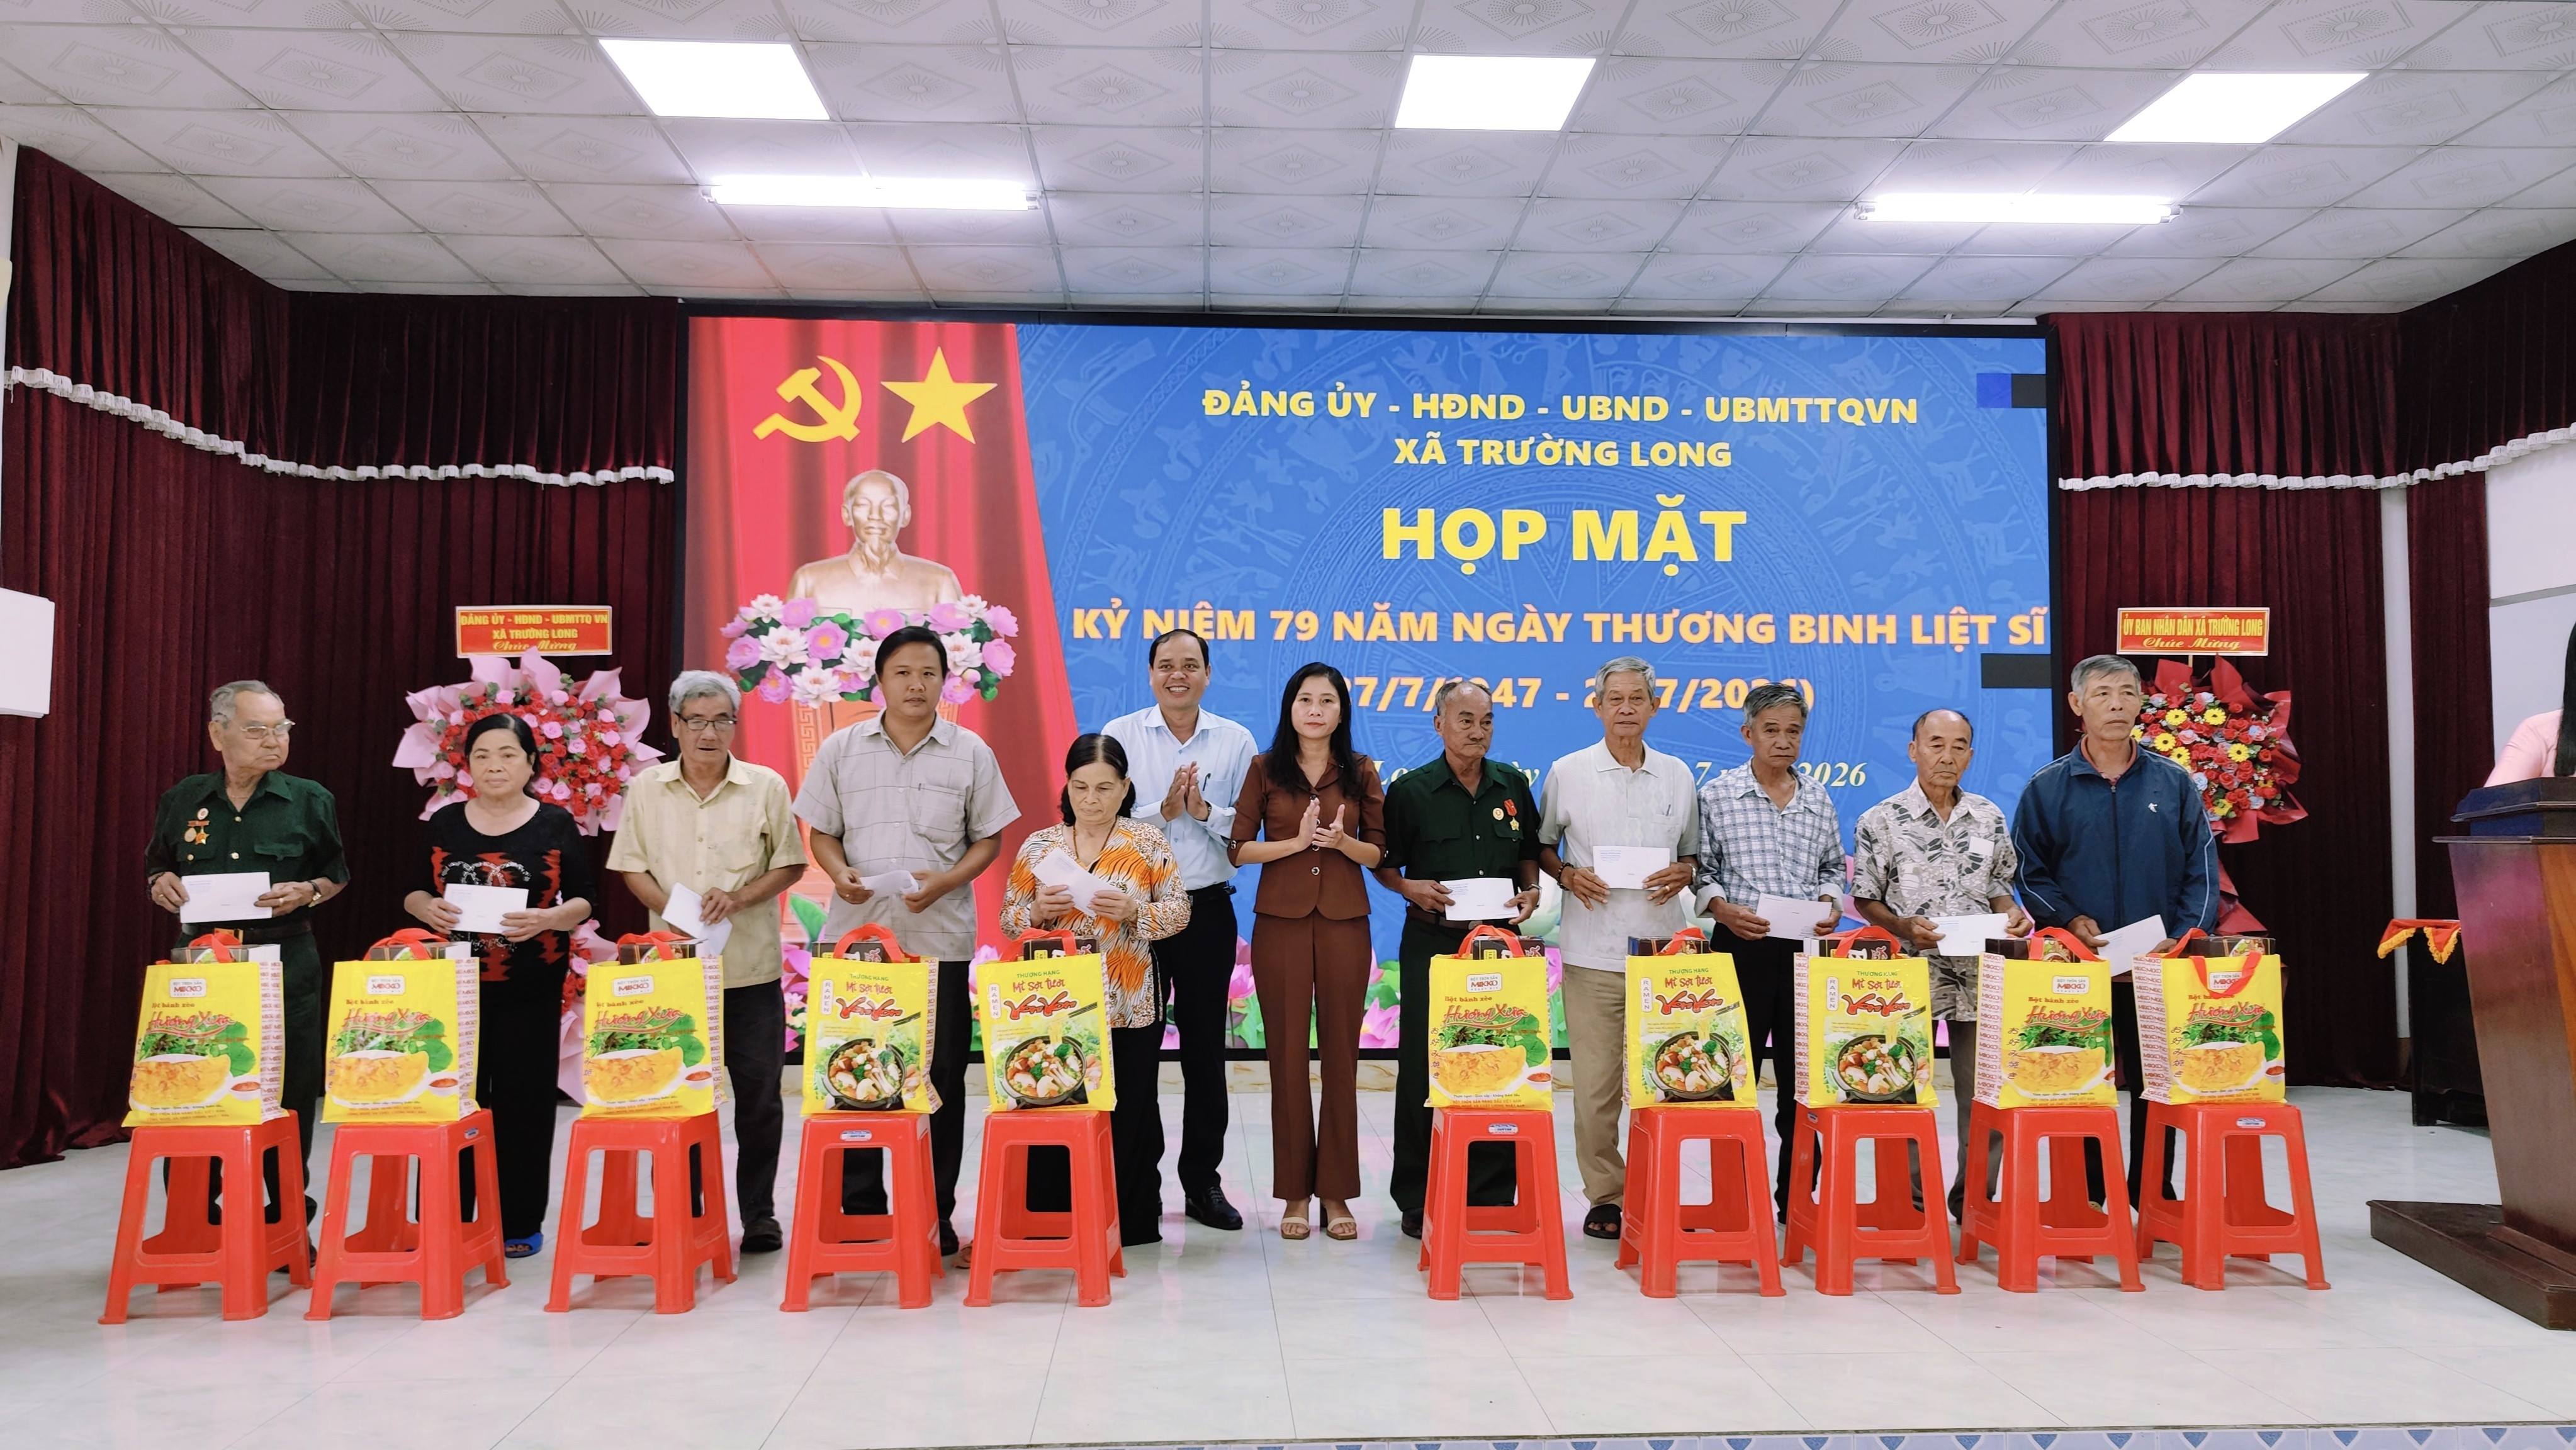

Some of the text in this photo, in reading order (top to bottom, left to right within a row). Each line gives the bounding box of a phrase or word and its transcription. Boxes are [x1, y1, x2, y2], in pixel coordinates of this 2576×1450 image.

[1202, 379, 1315, 417] ĐẢNG
[1327, 381, 1377, 418] ỦY
[1413, 393, 1526, 420] HĐND
[1562, 395, 1668, 421] UBND
[1706, 396, 1917, 426] UBMTTQVN
[1394, 431, 1731, 467] XÃ TRƯỜNG LONG
[1383, 494, 1746, 576] HỌP MẶT
[460, 613, 489, 625] ĐẢNG
[514, 614, 543, 625] HĐND
[551, 614, 592, 625] UBMTTQ
[594, 614, 609, 624] VN
[1073, 597, 1130, 639] KỶ
[1270, 610, 1319, 641] 79
[1333, 602, 1437, 641] NĂM
[1453, 604, 1573, 643] NGÀY
[1583, 608, 1776, 644] THƯƠNG
[1789, 614, 1897, 645] BINH
[1911, 605, 1996, 653] LIỆT
[2008, 606, 2049, 646] SĨ
[2135, 619, 2152, 636] BAN
[2153, 615, 2175, 636] NHÂN
[2177, 615, 2194, 636] DÂN
[2195, 616, 2207, 636] XÃ
[2208, 615, 2240, 636] TRƯỜNG
[2241, 619, 2263, 636] LONG
[509, 627, 549, 639] TRƯỜNG
[551, 629, 578, 639] LONG
[2143, 637, 2241, 650] Chúc Mừng
[537, 640, 577, 651] Mừng
[1694, 762, 1713, 785] 7
[1442, 1005, 1493, 1023] Hương
